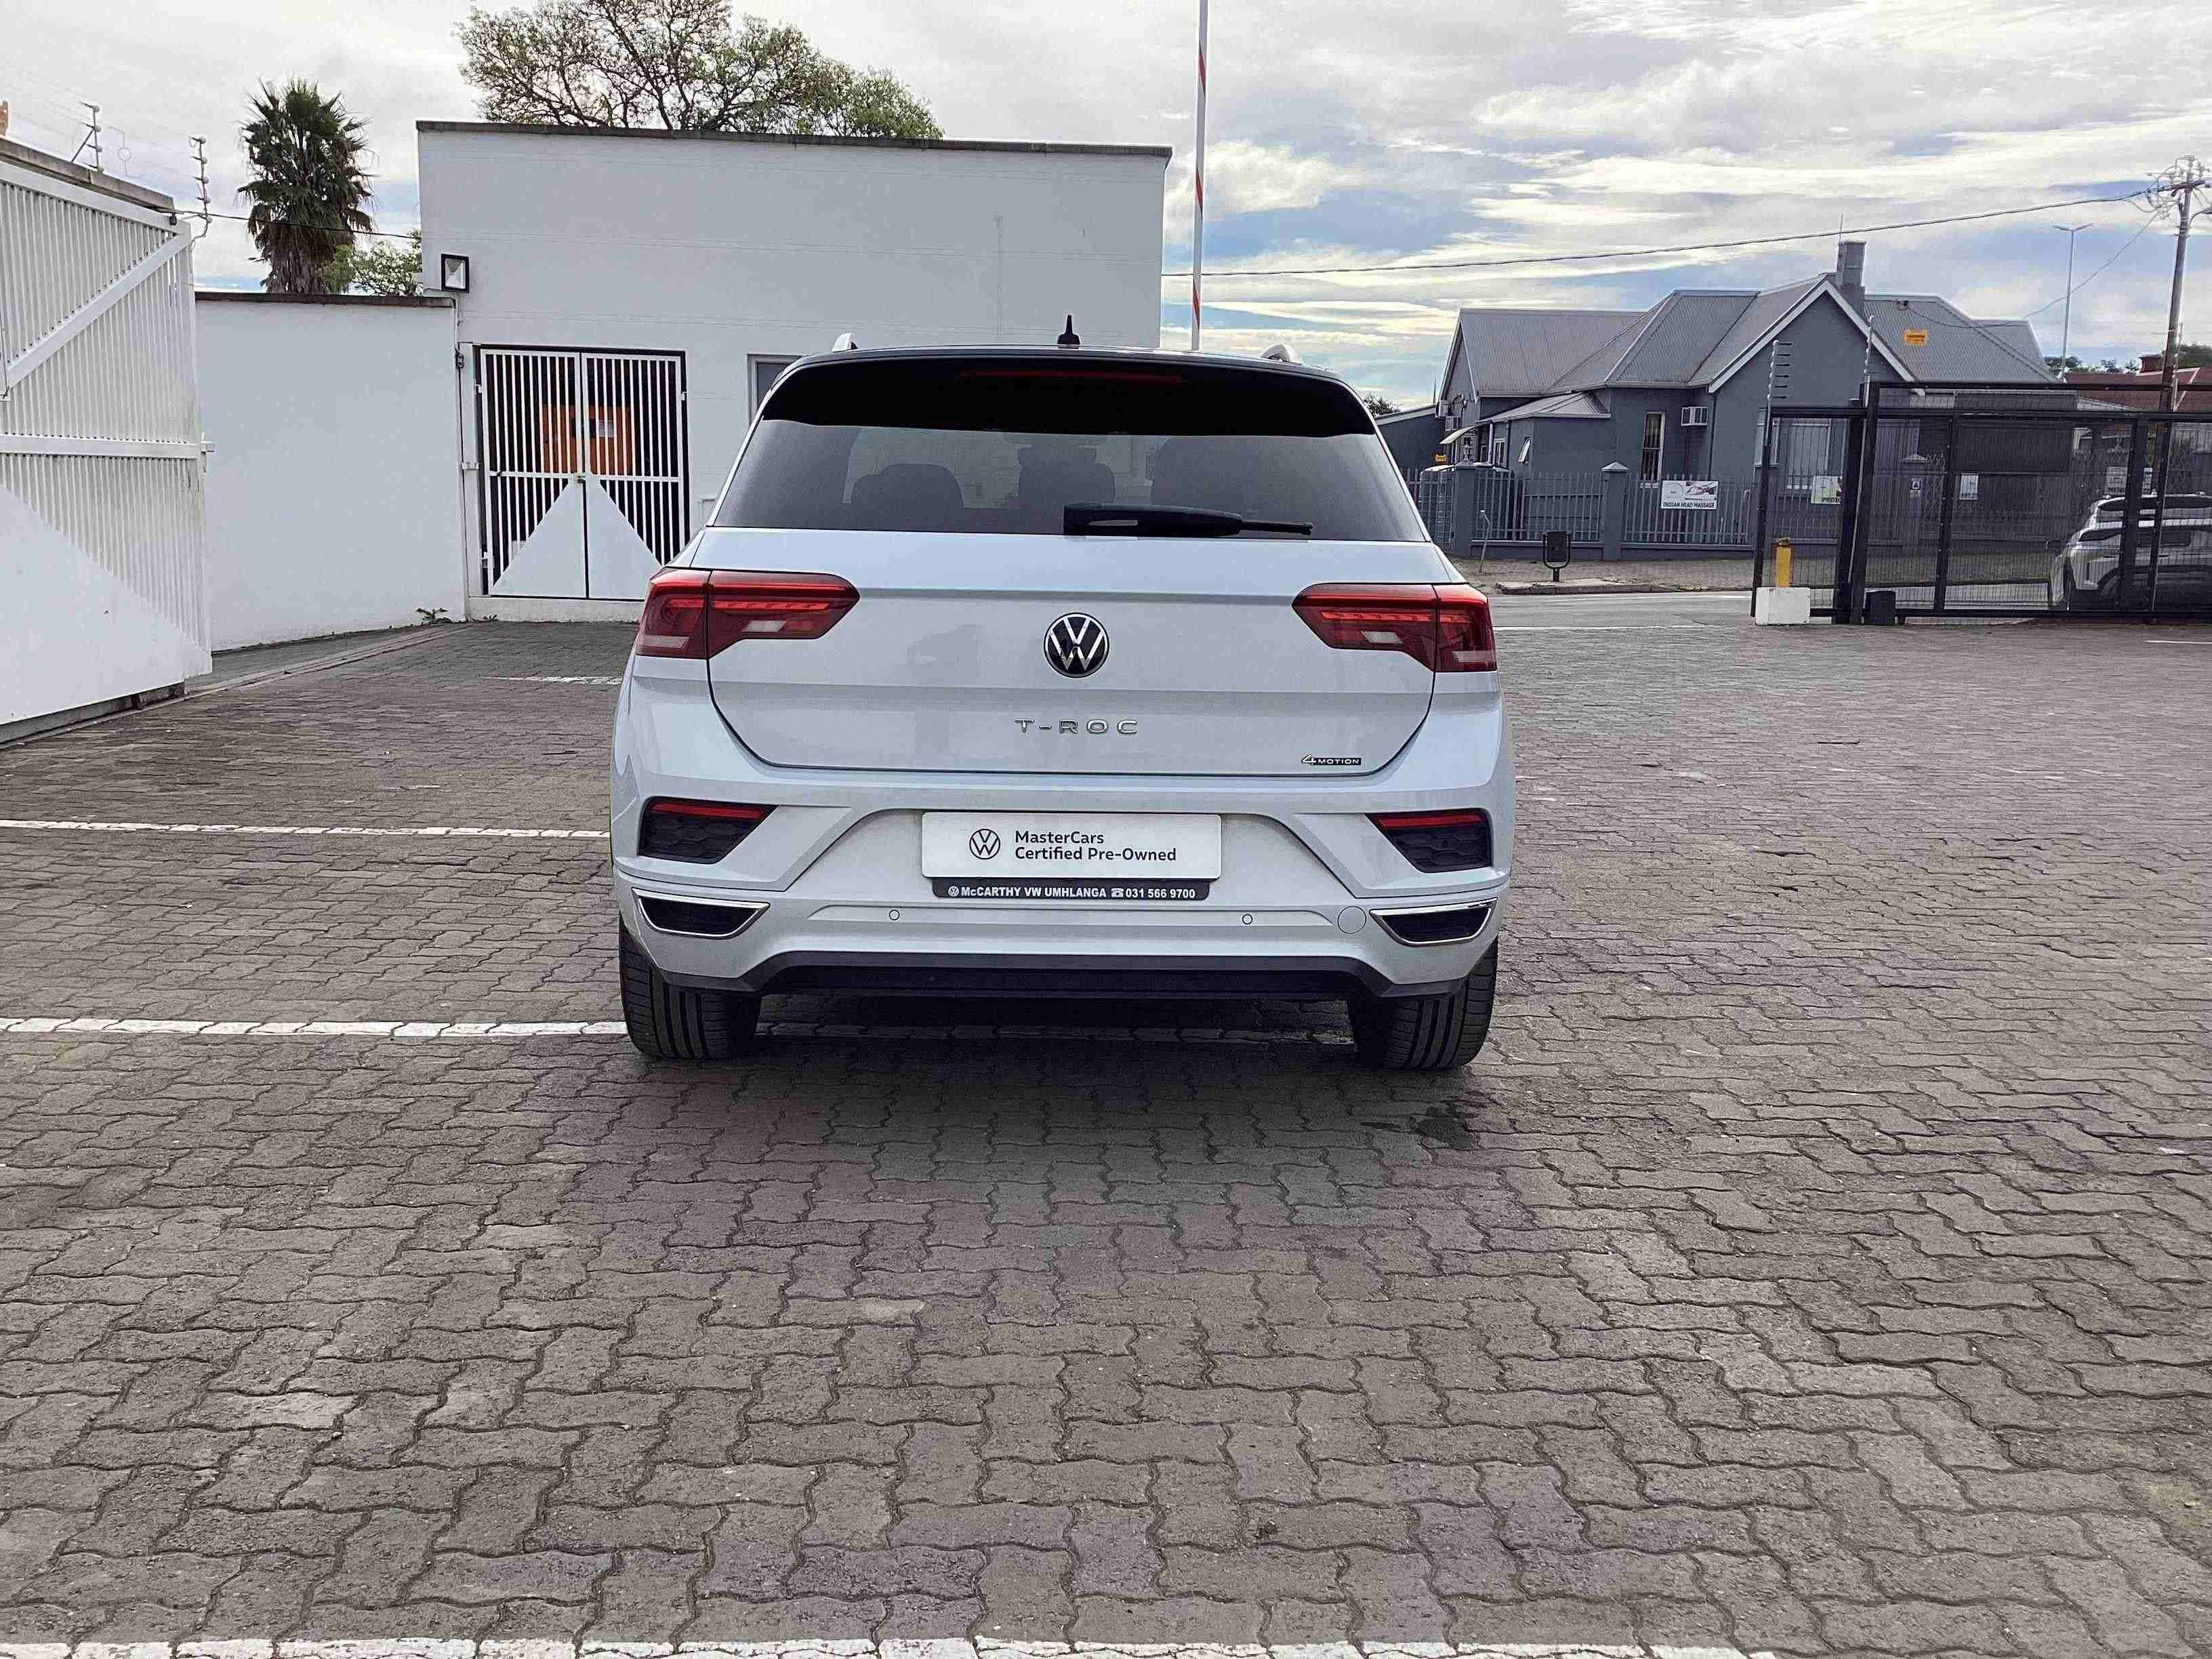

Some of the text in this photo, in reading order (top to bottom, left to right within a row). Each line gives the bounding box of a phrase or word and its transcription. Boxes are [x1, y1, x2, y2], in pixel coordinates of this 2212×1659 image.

[1015, 718, 1138, 735] T-ROC
[1301, 754, 1360, 765] 4MOTION
[1015, 830, 1104, 844] MasterCars
[1015, 846, 1176, 861] Certified Pre-Owned
[961, 886, 1195, 899] McCARTHY VW UMHLANGA 031 566 9700
